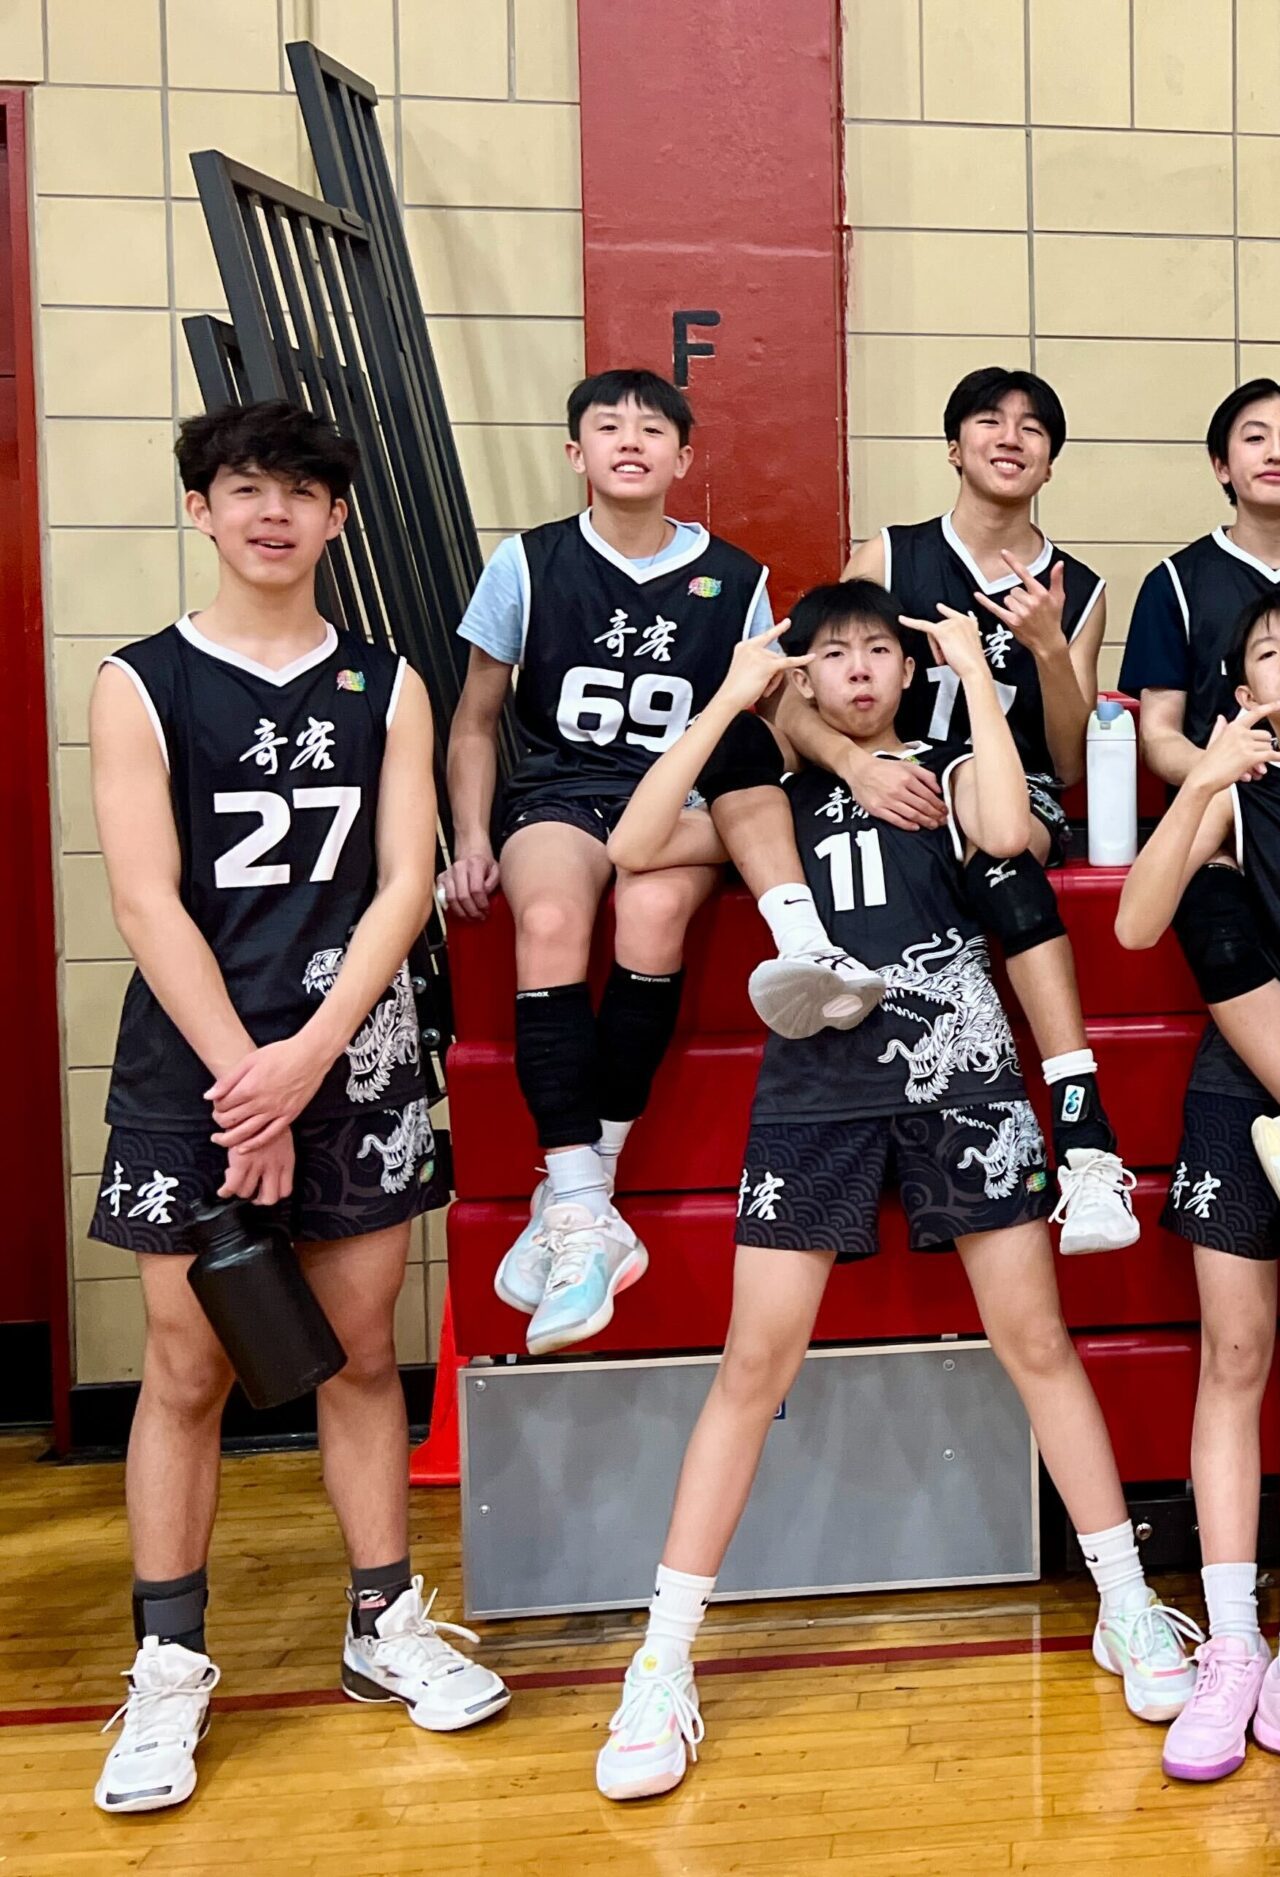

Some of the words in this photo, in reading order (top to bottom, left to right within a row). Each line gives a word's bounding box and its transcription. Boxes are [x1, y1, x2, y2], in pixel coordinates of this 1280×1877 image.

[673, 310, 721, 387] F
[556, 666, 694, 753] 69
[213, 786, 362, 889] 27
[813, 827, 888, 912] 11
